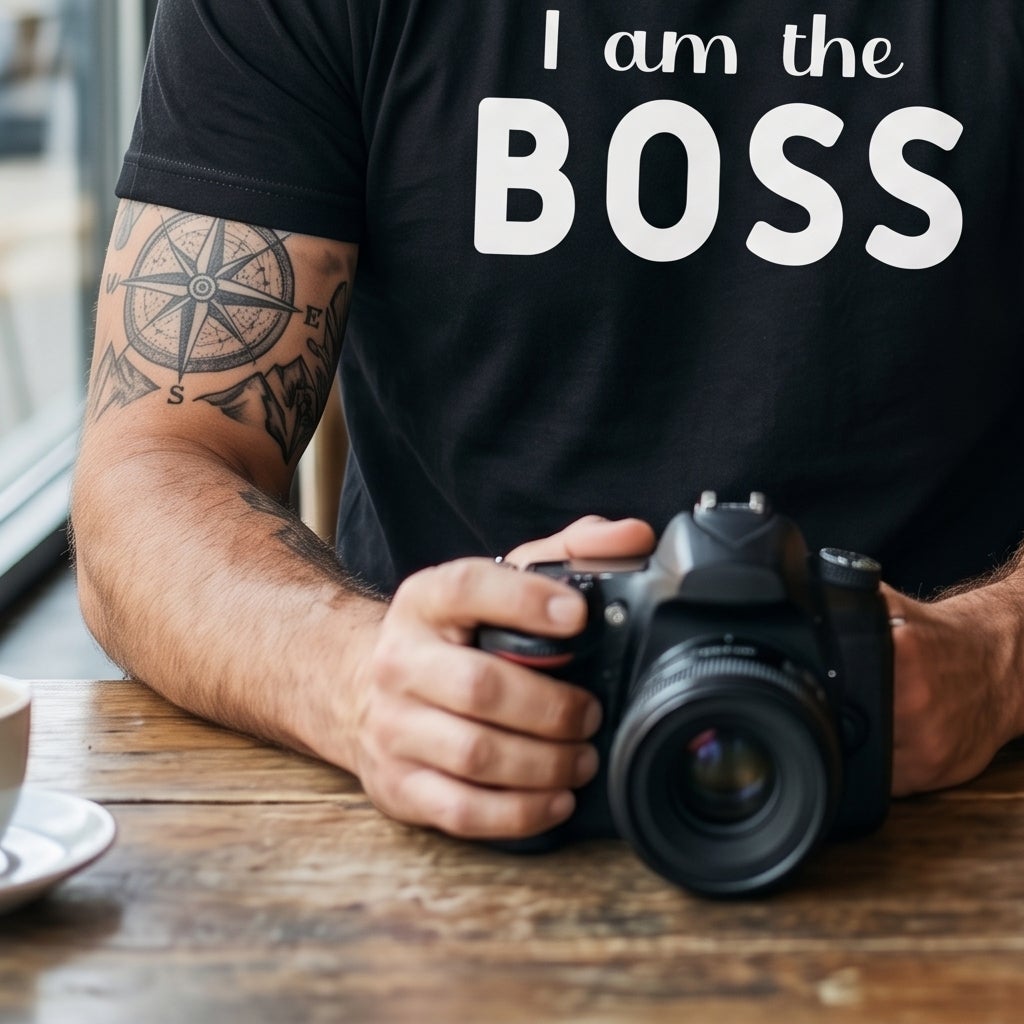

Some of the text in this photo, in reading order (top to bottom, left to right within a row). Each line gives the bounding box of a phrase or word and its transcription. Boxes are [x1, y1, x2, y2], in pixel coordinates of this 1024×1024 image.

[543, 9, 904, 79] I am the
[473, 96, 964, 270] BOSS
[303, 304, 323, 329] E
[166, 384, 185, 405] S
